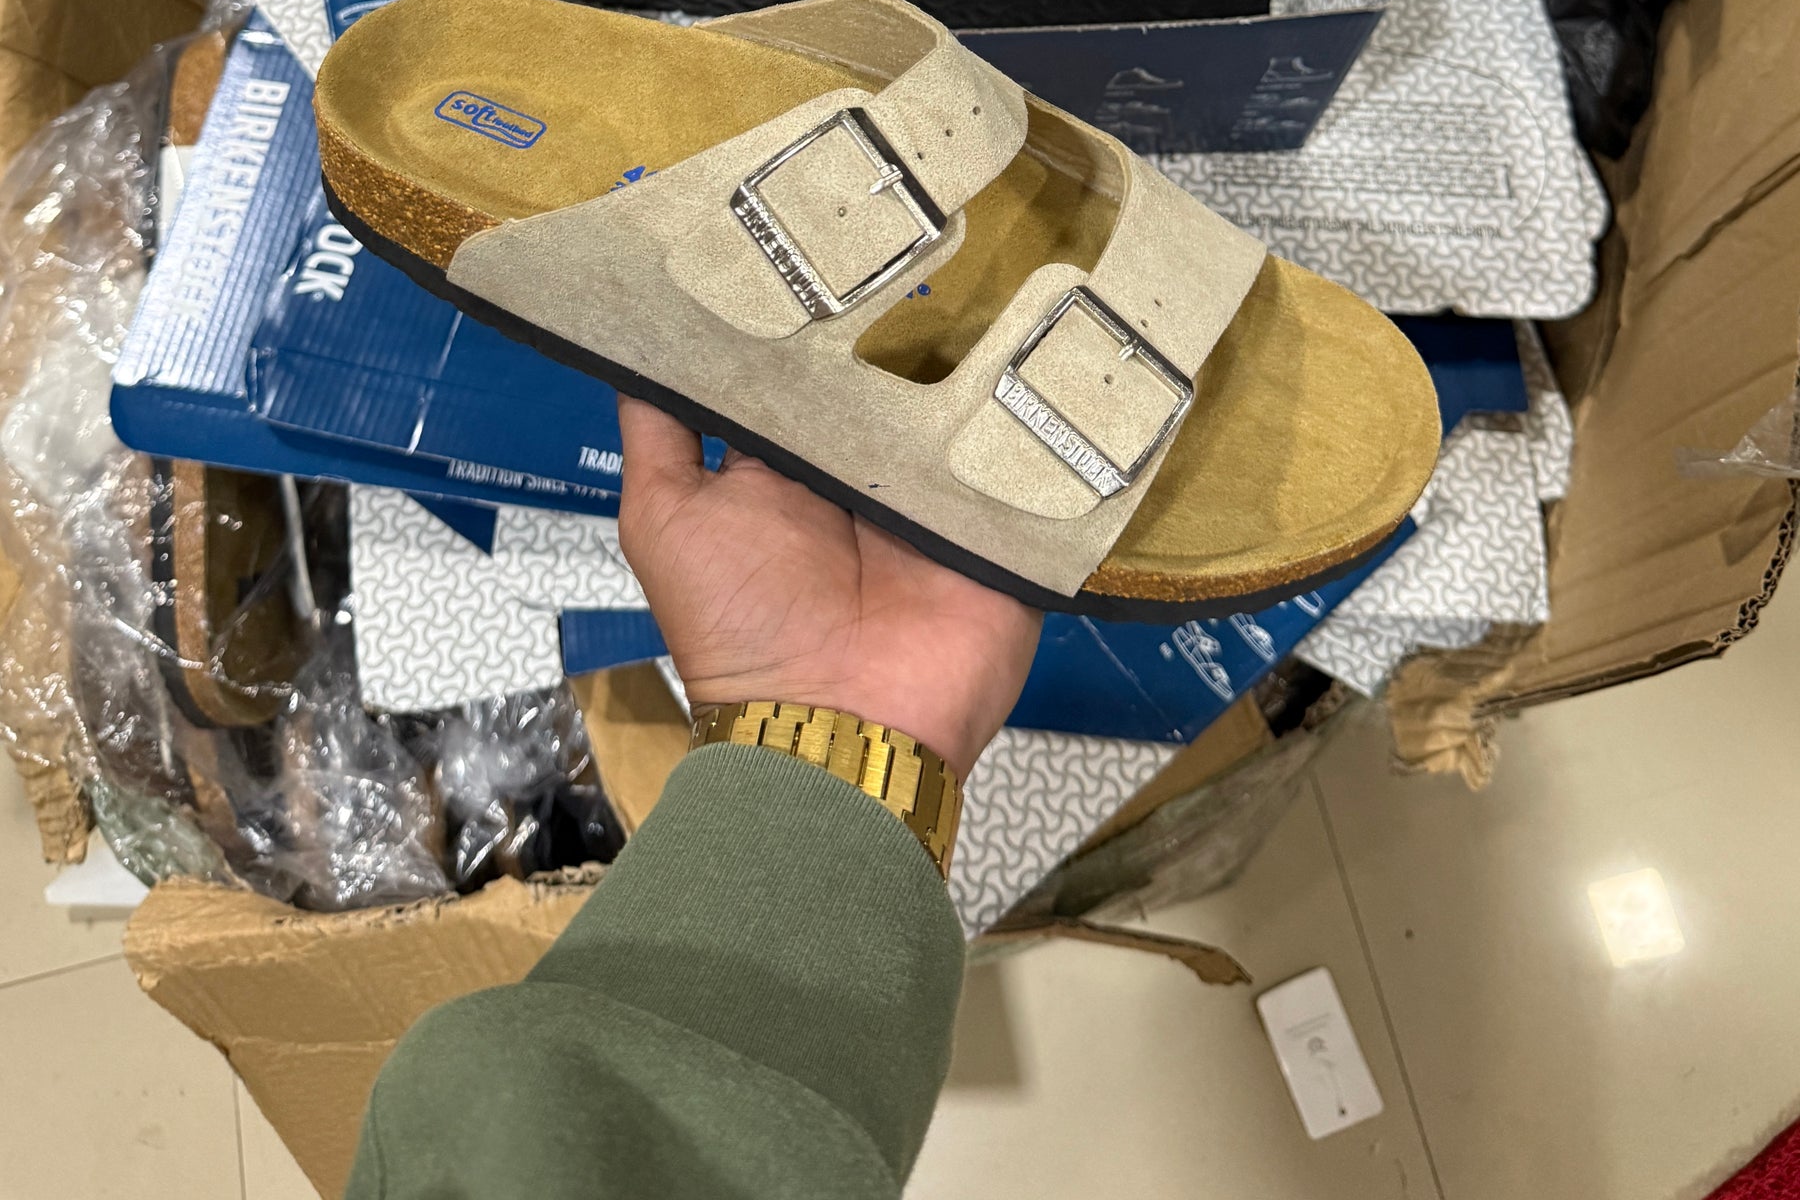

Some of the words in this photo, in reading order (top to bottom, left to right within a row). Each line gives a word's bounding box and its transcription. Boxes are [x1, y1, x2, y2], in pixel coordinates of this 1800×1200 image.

[170, 79, 291, 316] BIRKENSTOCK
[293, 211, 363, 302] OCK
[1001, 380, 1114, 491] BIRKENSTOCK
